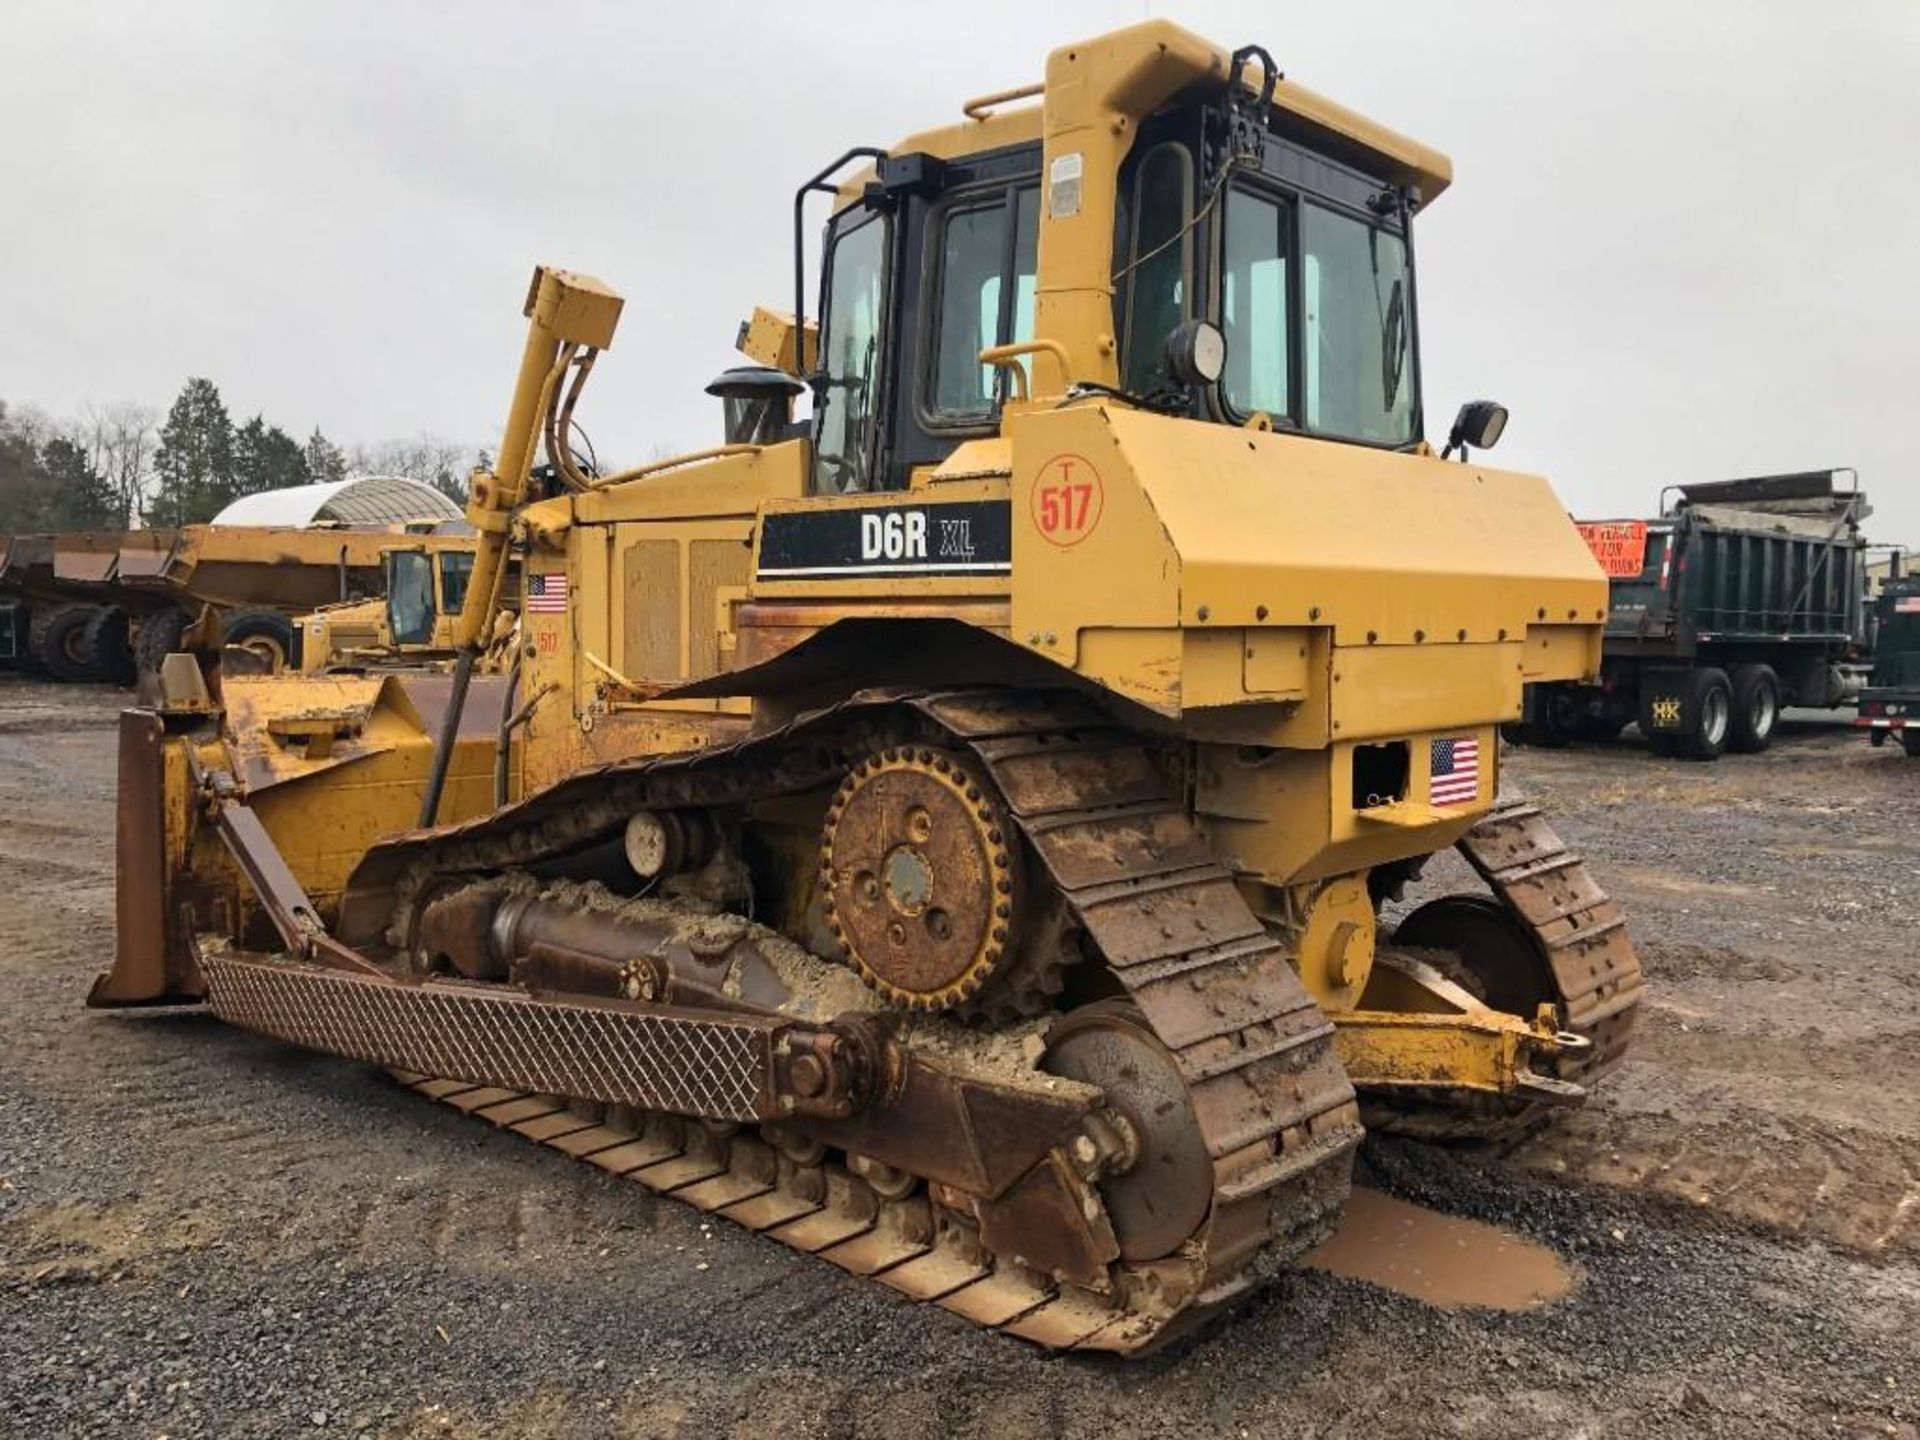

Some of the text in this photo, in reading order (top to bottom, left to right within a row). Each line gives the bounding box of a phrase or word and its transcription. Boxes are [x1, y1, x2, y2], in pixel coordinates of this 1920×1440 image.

[1059, 463, 1074, 482] T
[1041, 485, 1094, 533] 517
[861, 511, 975, 560] D6R XL
